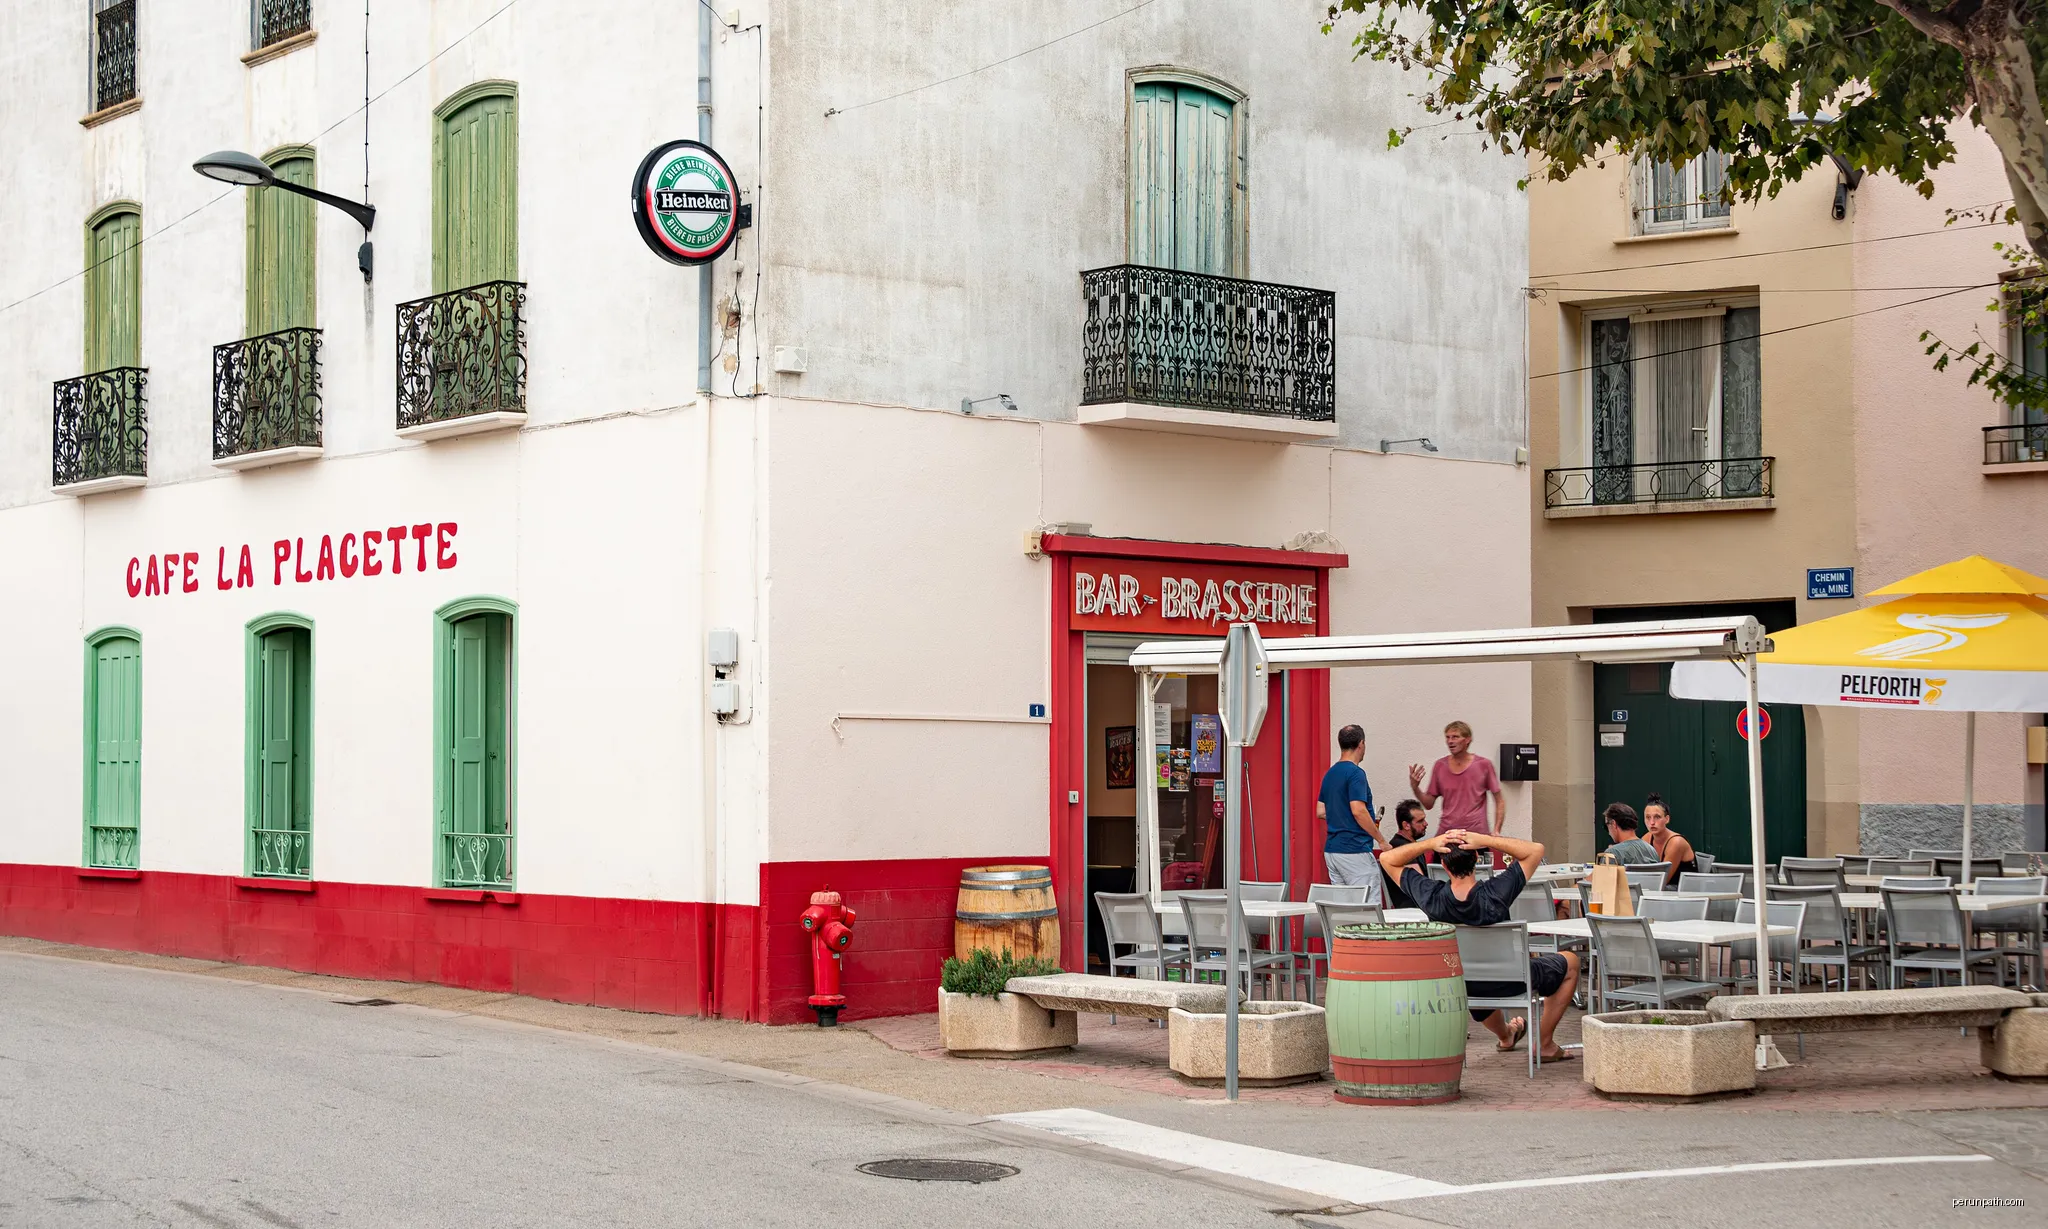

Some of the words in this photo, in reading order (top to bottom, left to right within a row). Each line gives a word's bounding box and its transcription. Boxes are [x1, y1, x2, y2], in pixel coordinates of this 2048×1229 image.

[665, 162, 686, 181] BIERE
[686, 160, 719, 181] HEINEKEN
[661, 193, 728, 210] Heineken
[667, 218, 686, 240] BIERE
[686, 234, 696, 245] DE
[697, 221, 726, 245] PRESTIGE
[126, 552, 199, 598] CAFE
[217, 544, 254, 590] LA
[273, 522, 458, 586] PLACETTE
[1815, 573, 1845, 582] CHEMIN
[1828, 584, 1849, 593] MINE
[1161, 576, 1317, 624] BRASSERIE
[1840, 674, 1921, 697] PELFORTH
[1035, 705, 1039, 716] 1
[1616, 711, 1623, 720] 5
